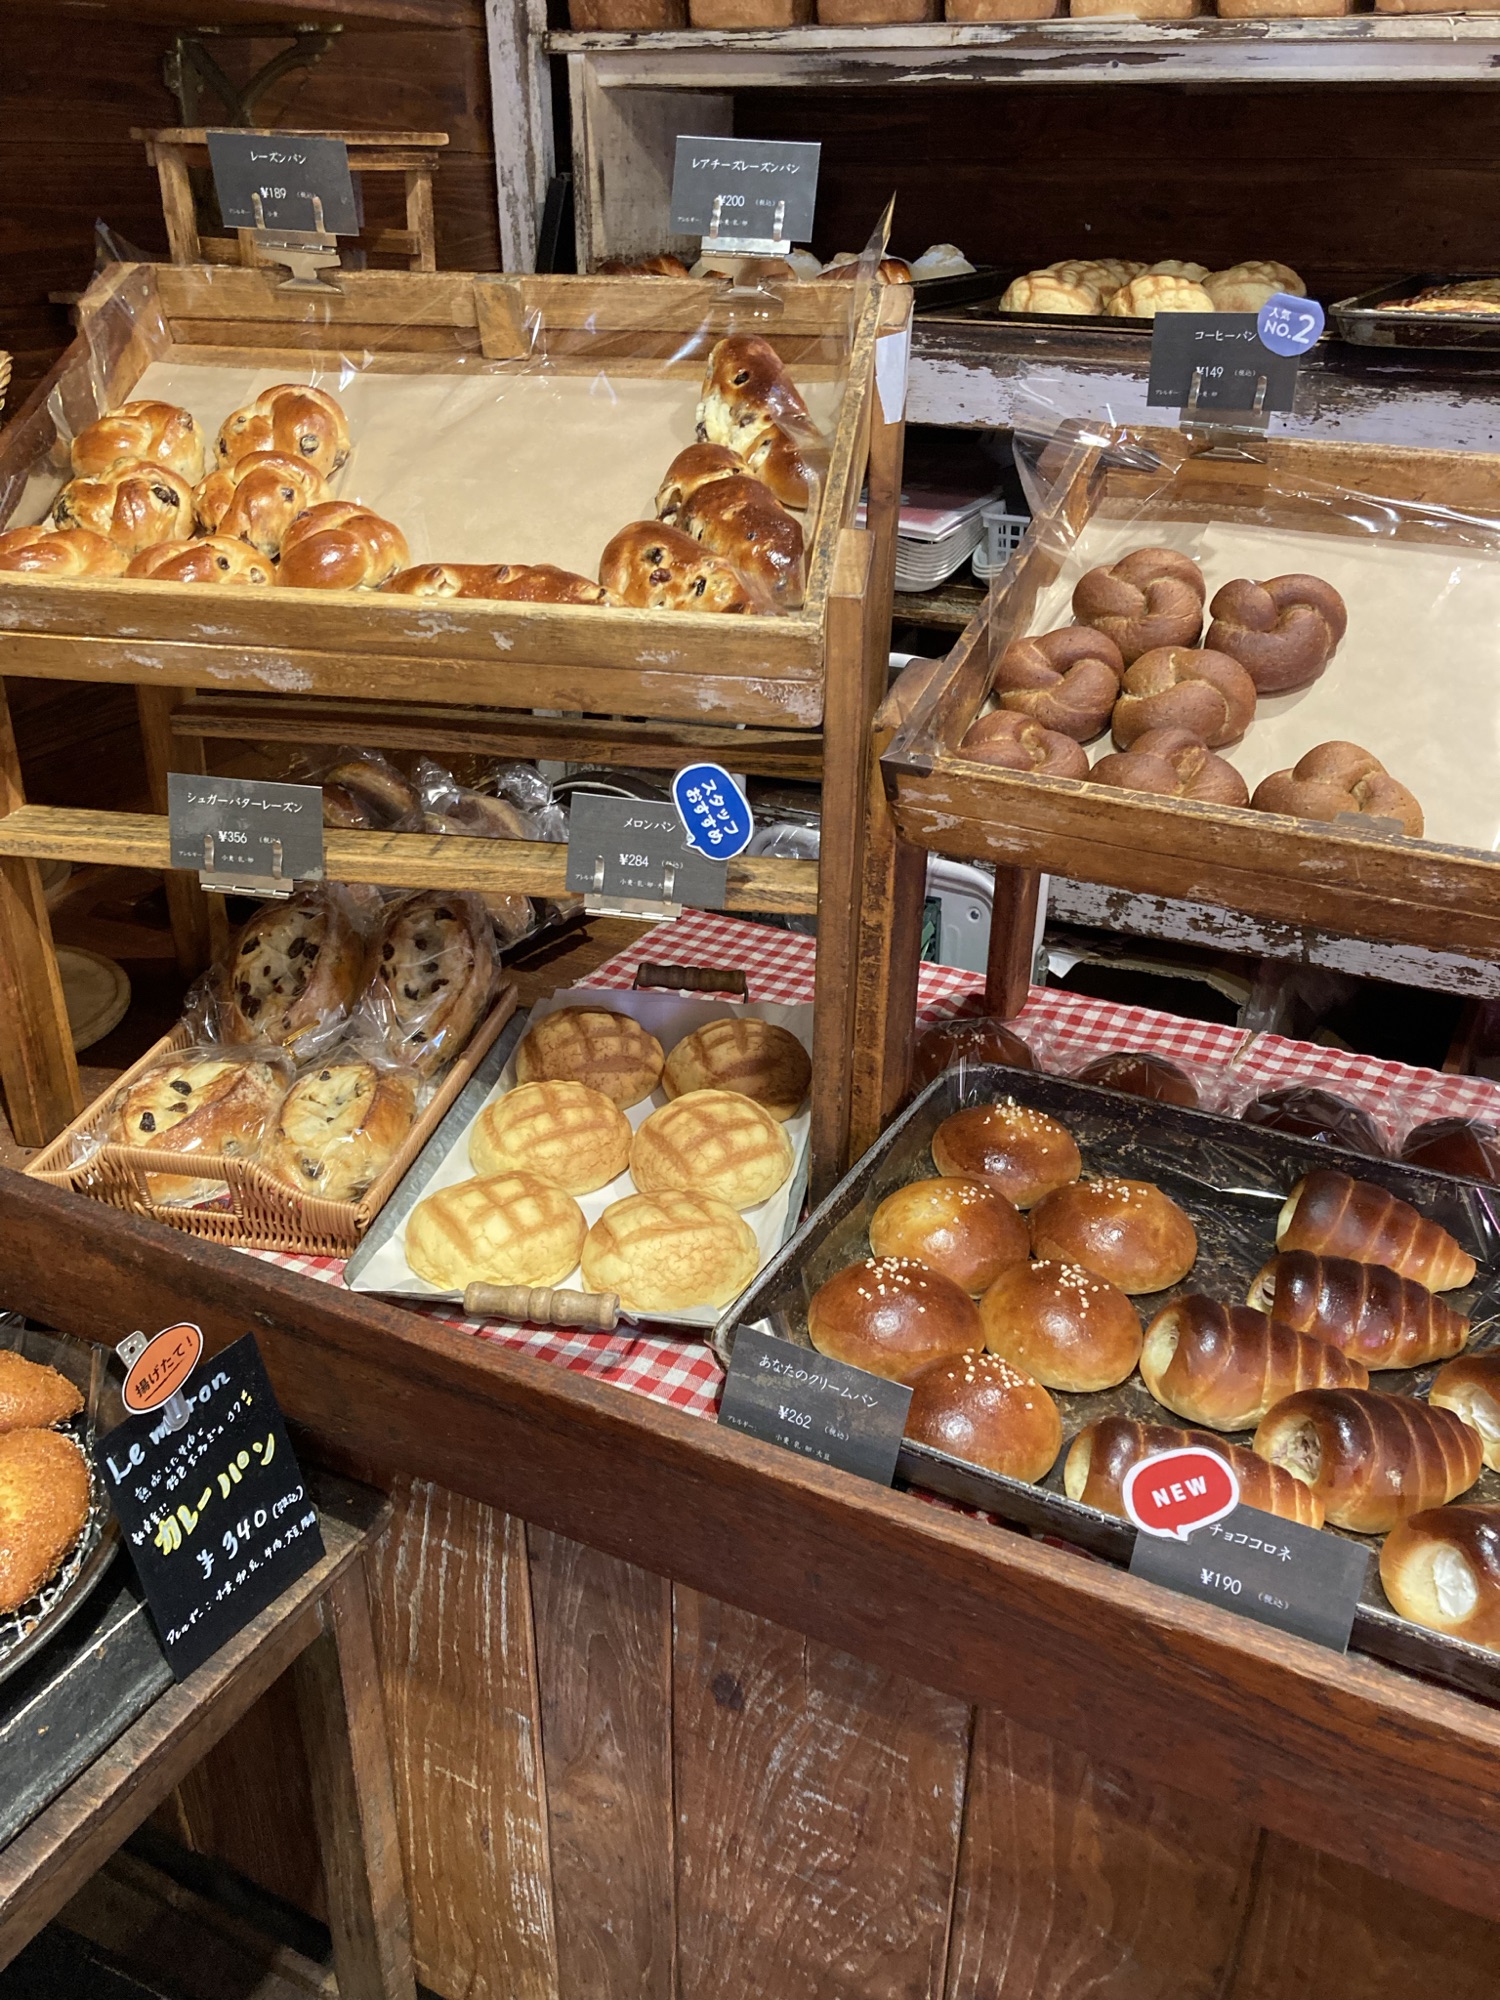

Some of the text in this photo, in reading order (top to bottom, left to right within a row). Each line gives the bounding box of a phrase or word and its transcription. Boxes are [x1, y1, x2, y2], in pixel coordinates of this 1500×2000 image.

[250, 151, 307, 165] レーズンパン
[692, 158, 801, 174] レアチーズレーズンパン
[260, 186, 287, 199] ¥189
[1269, 307, 1292, 321] 人気
[1195, 330, 1258, 342] コーヒーパン
[1264, 314, 1316, 344] NO.2
[1196, 366, 1224, 378] ¥149
[187, 792, 303, 814] シュガーバターレーズン
[685, 786, 724, 845] おすすめ
[701, 779, 740, 835] スタッフ
[218, 830, 248, 844] ¥356
[624, 817, 677, 833] メロンパン
[619, 853, 649, 868] ¥284
[134, 1336, 194, 1398] 揚げたて！
[759, 1354, 878, 1408] あなたのクリームパン
[106, 1371, 231, 1485] Le mron
[778, 1405, 850, 1442] ¥262 （税込）
[154, 1433, 275, 1556] カレーパン
[1151, 1475, 1208, 1508] NEW
[1209, 1523, 1292, 1563] チョココロネ
[1200, 1568, 1242, 1595] ¥190
